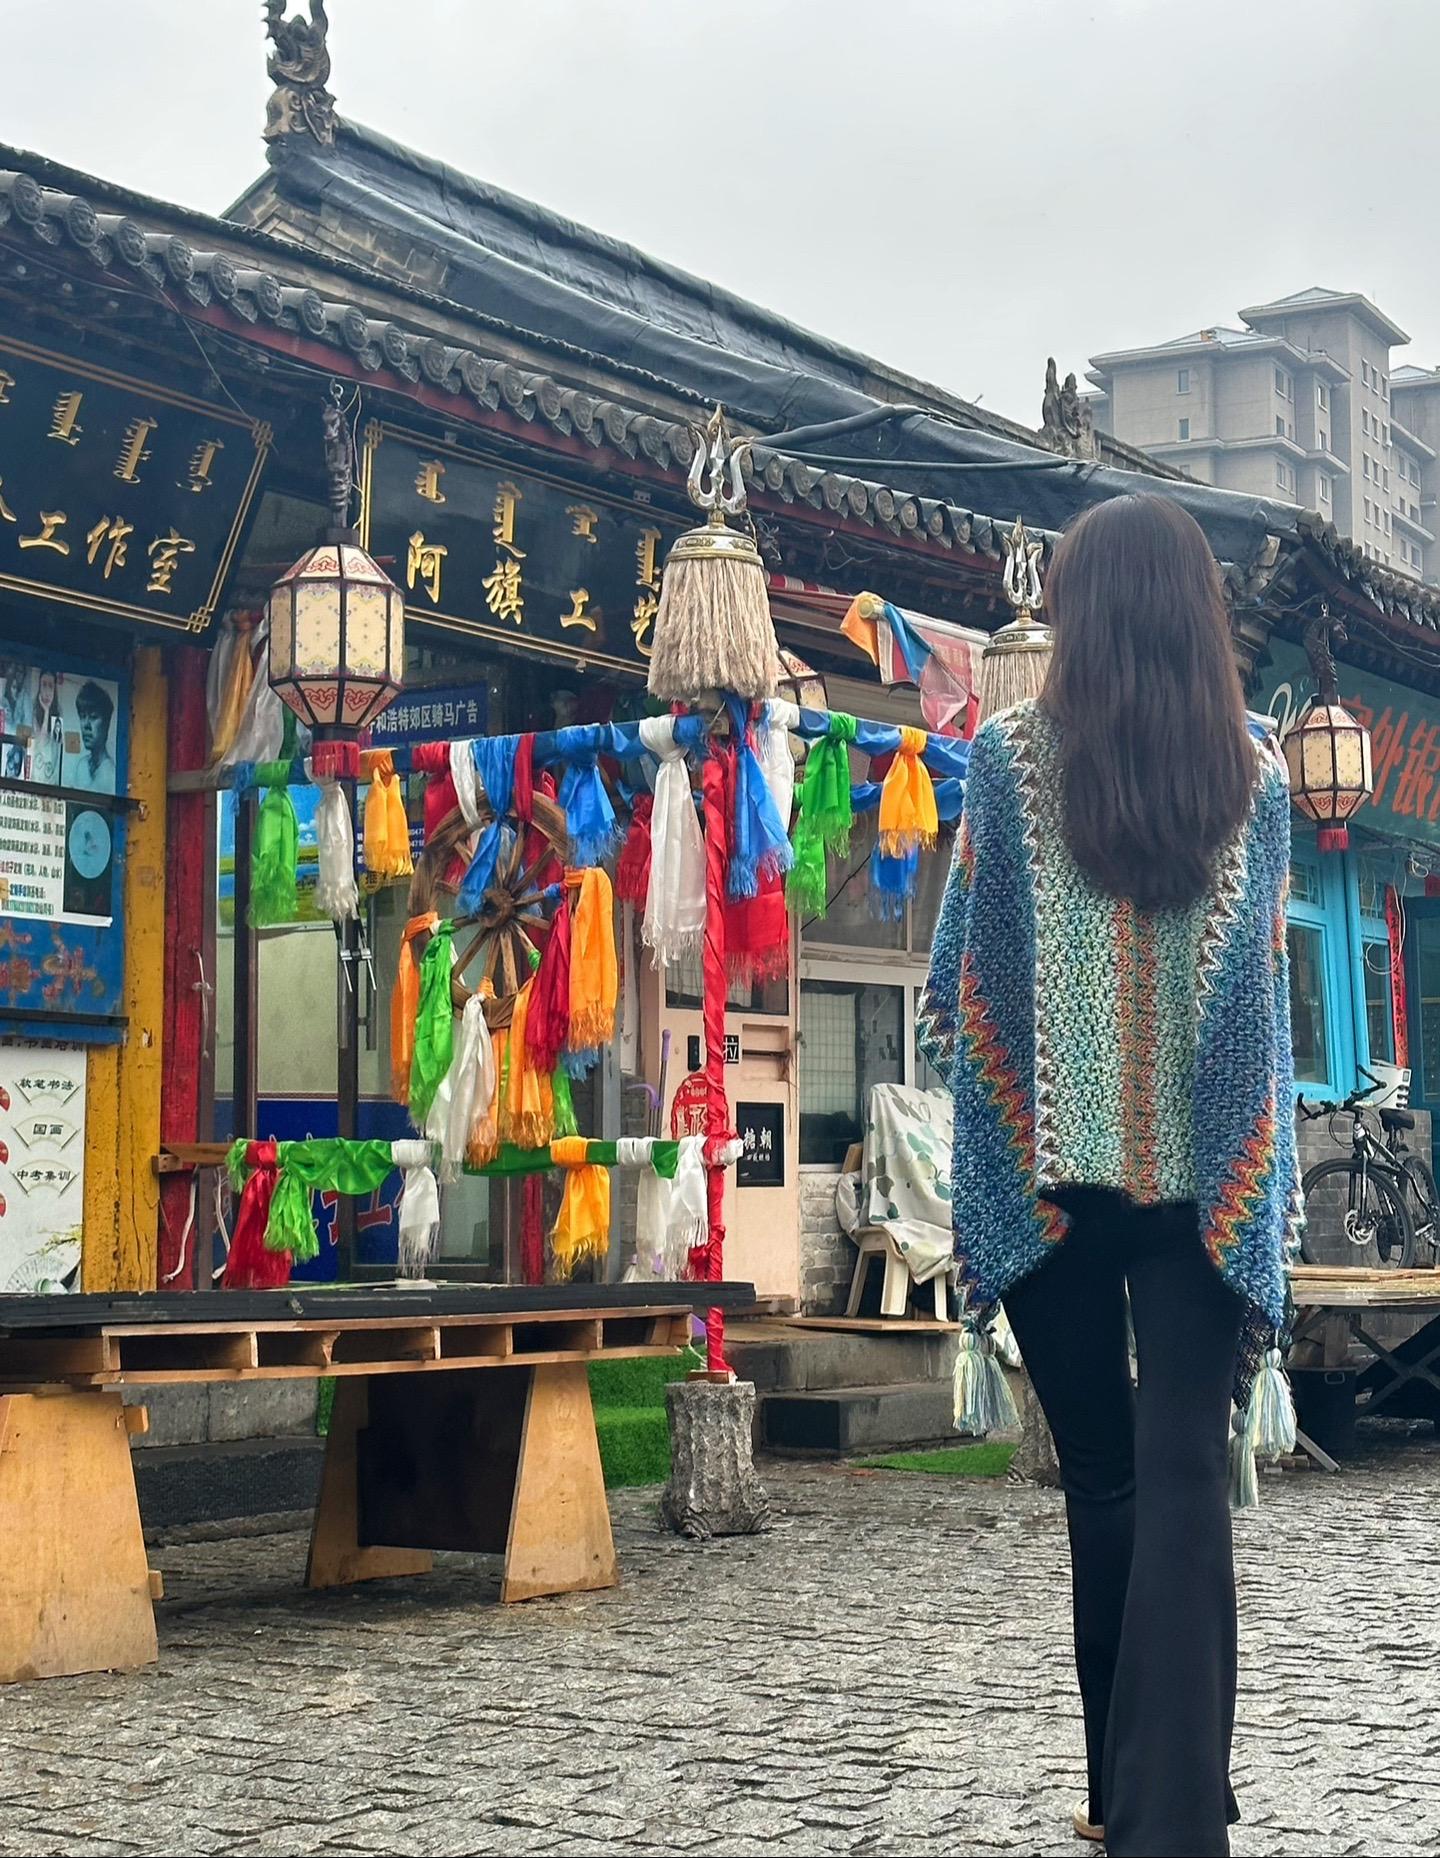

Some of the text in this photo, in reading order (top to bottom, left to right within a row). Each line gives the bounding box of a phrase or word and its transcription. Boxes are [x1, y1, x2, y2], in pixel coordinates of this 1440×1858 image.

[0, 478, 196, 594] 工作室
[722, 1035, 739, 1063] 拉
[19, 1078, 74, 1091] 软笔书法
[32, 1123, 64, 1136] 国画
[16, 1169, 71, 1182] 中考集训
